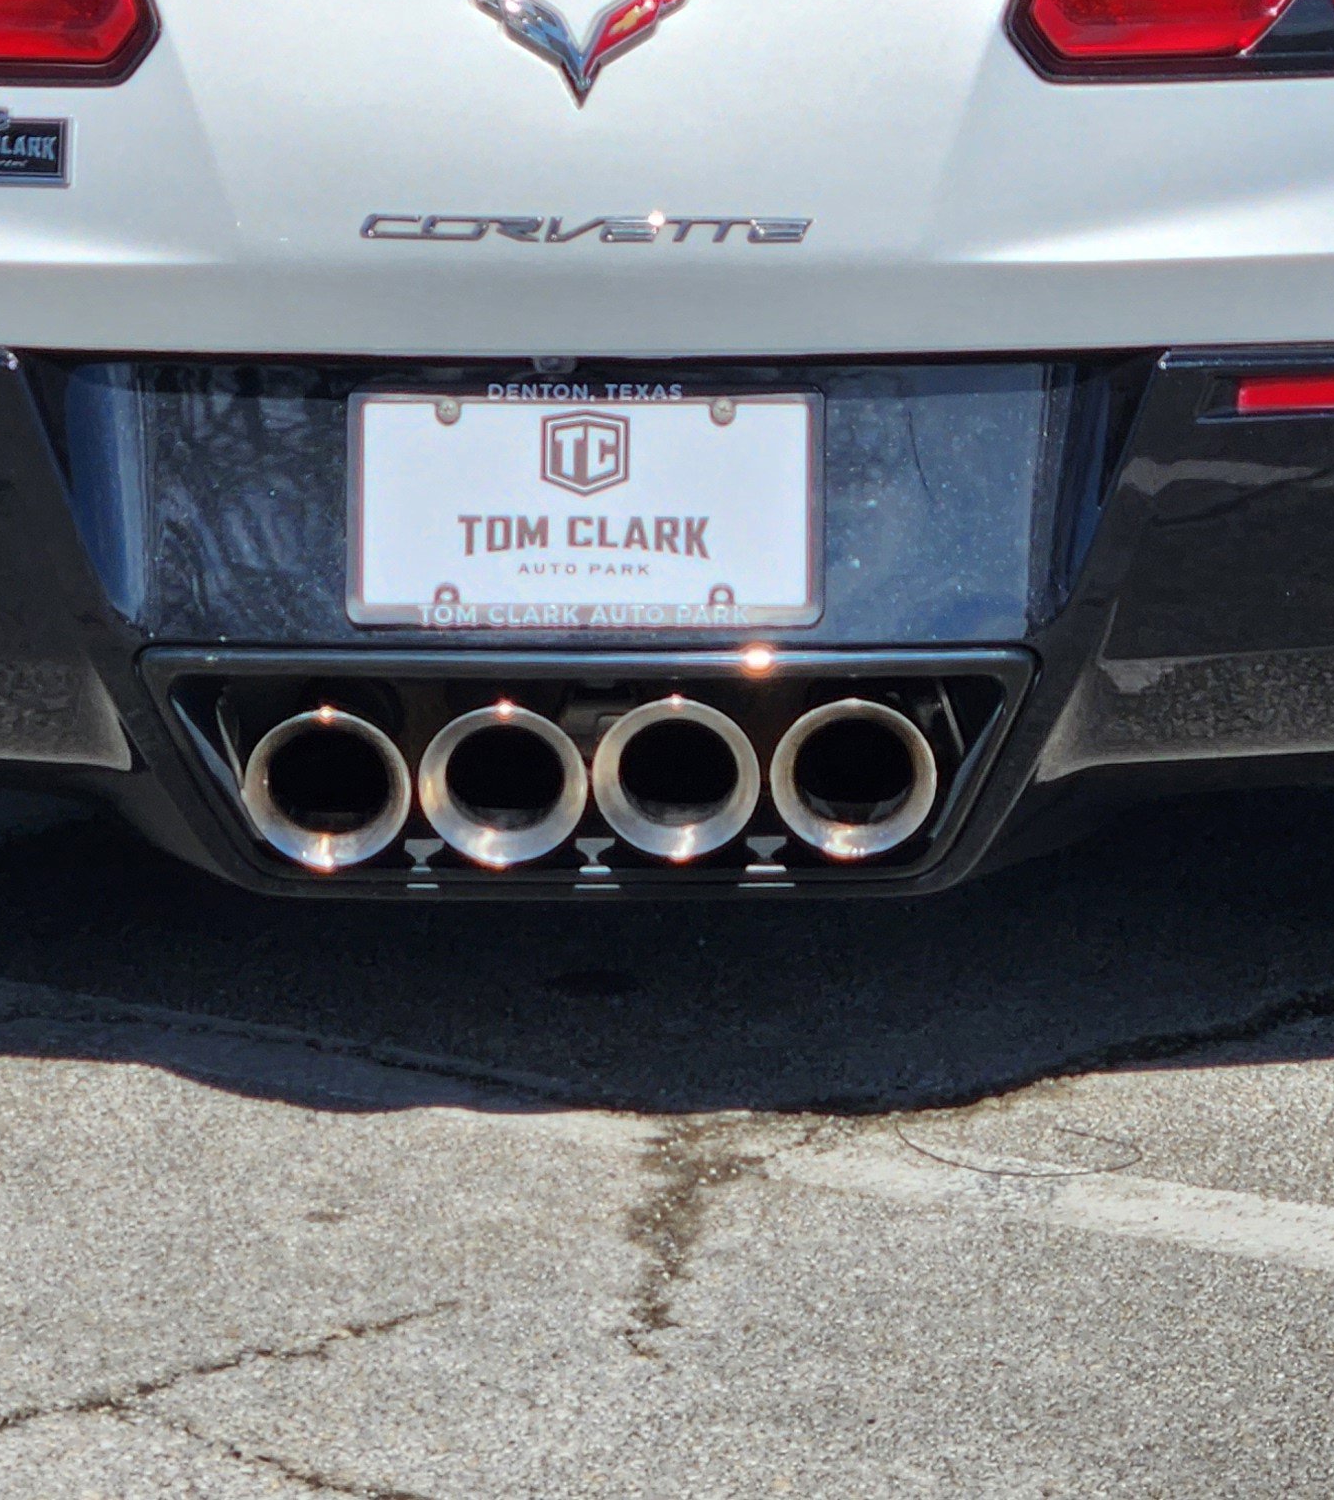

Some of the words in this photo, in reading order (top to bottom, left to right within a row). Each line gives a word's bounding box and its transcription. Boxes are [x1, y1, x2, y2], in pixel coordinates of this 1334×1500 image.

[359, 214, 815, 243] CORVETTE
[604, 383, 684, 401] TEXAS
[457, 514, 549, 557] TOM
[567, 515, 711, 560] CLARK
[518, 563, 577, 575] AUTO
[589, 563, 651, 576] PARK
[419, 604, 478, 626] TOM
[489, 604, 578, 626] CLARK
[589, 604, 665, 626] AUTO
[677, 604, 750, 626] PARK
